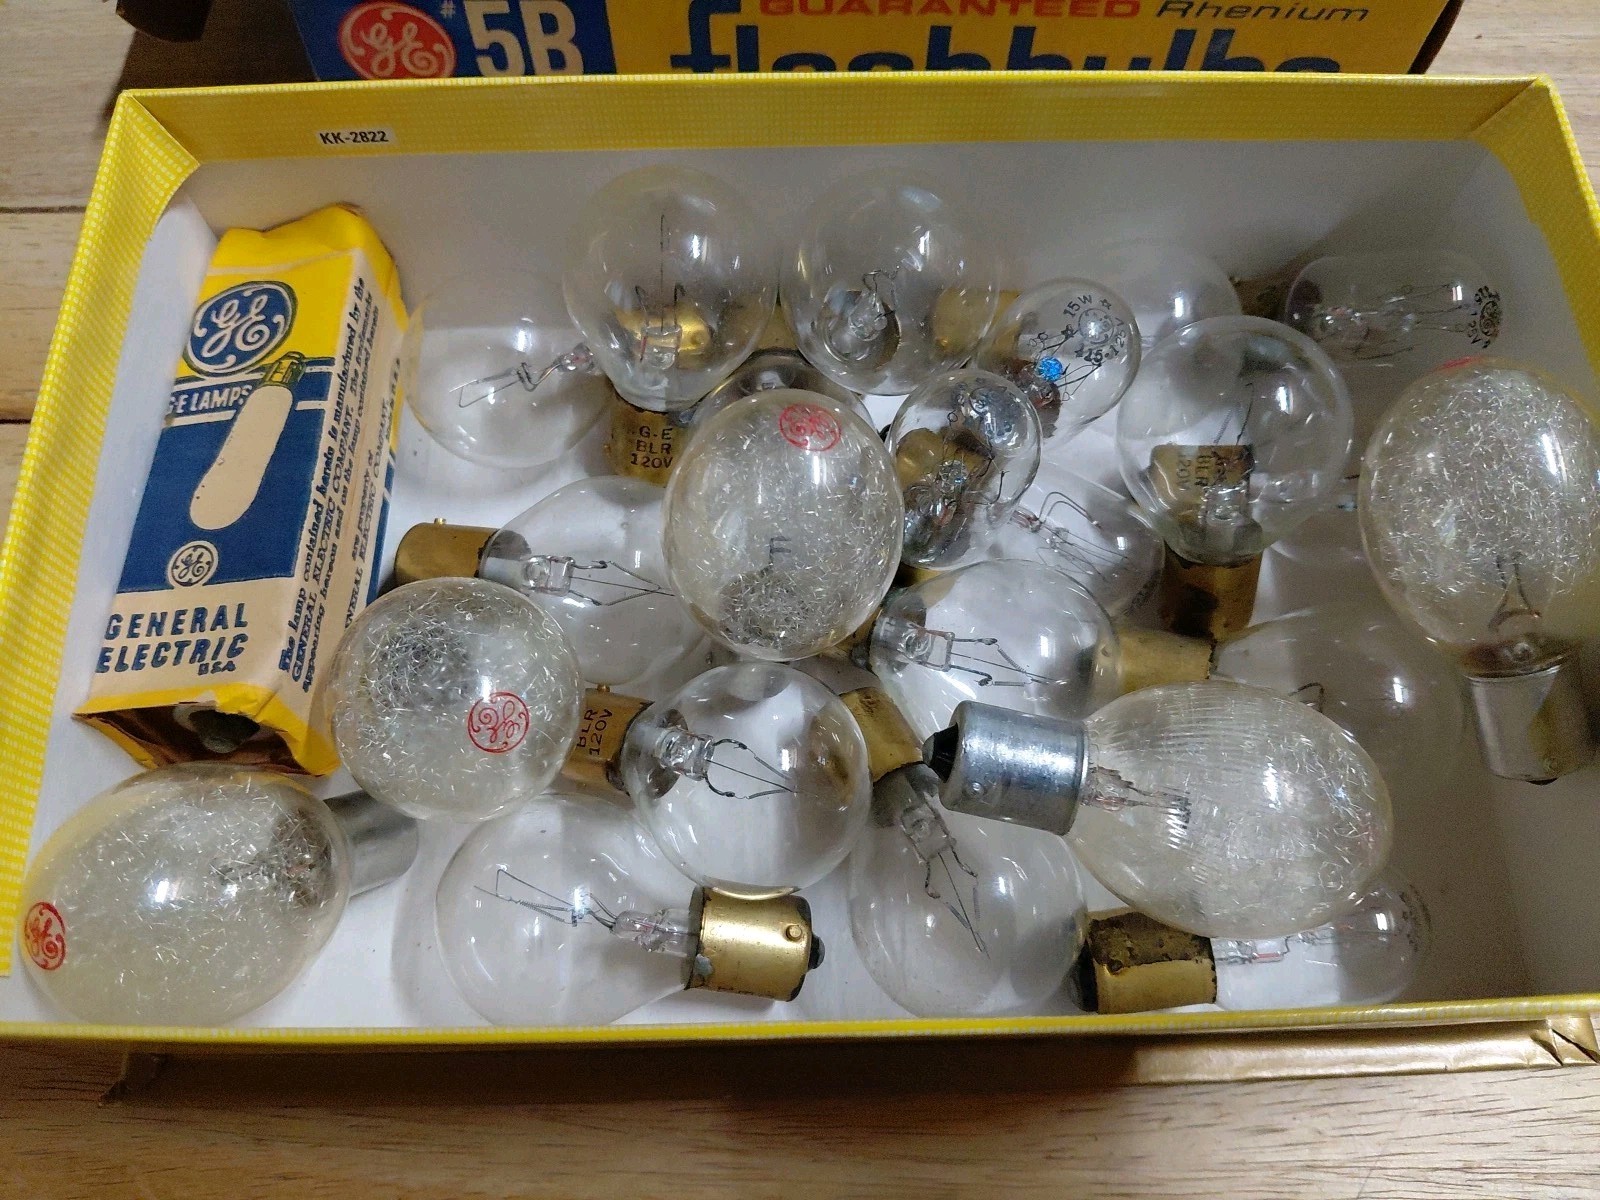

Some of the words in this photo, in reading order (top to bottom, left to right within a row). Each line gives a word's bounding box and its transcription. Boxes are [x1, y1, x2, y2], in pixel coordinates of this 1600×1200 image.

[760, 0, 1139, 17] GUARANTEED
[1156, 0, 1369, 22] Rhenium
[319, 131, 389, 145] KK-2822
[354, 278, 365, 302] the
[1063, 294, 1092, 318] 15W
[349, 303, 361, 324] by
[333, 323, 356, 424] manufactured
[327, 424, 339, 443] is
[636, 439, 672, 455] BLR
[315, 445, 335, 499] herein
[630, 453, 674, 469] 120V
[304, 500, 325, 582] contained
[292, 593, 317, 681] GENERAL
[312, 496, 336, 585] ELECTRIC
[303, 604, 325, 693] appearing
[334, 505, 344, 540] and
[343, 458, 354, 485] the
[104, 602, 249, 641] GENERAL
[288, 588, 306, 632] lamp
[94, 632, 249, 674] ELECTRIC
[279, 636, 295, 673] The
[589, 708, 613, 756] 120V
